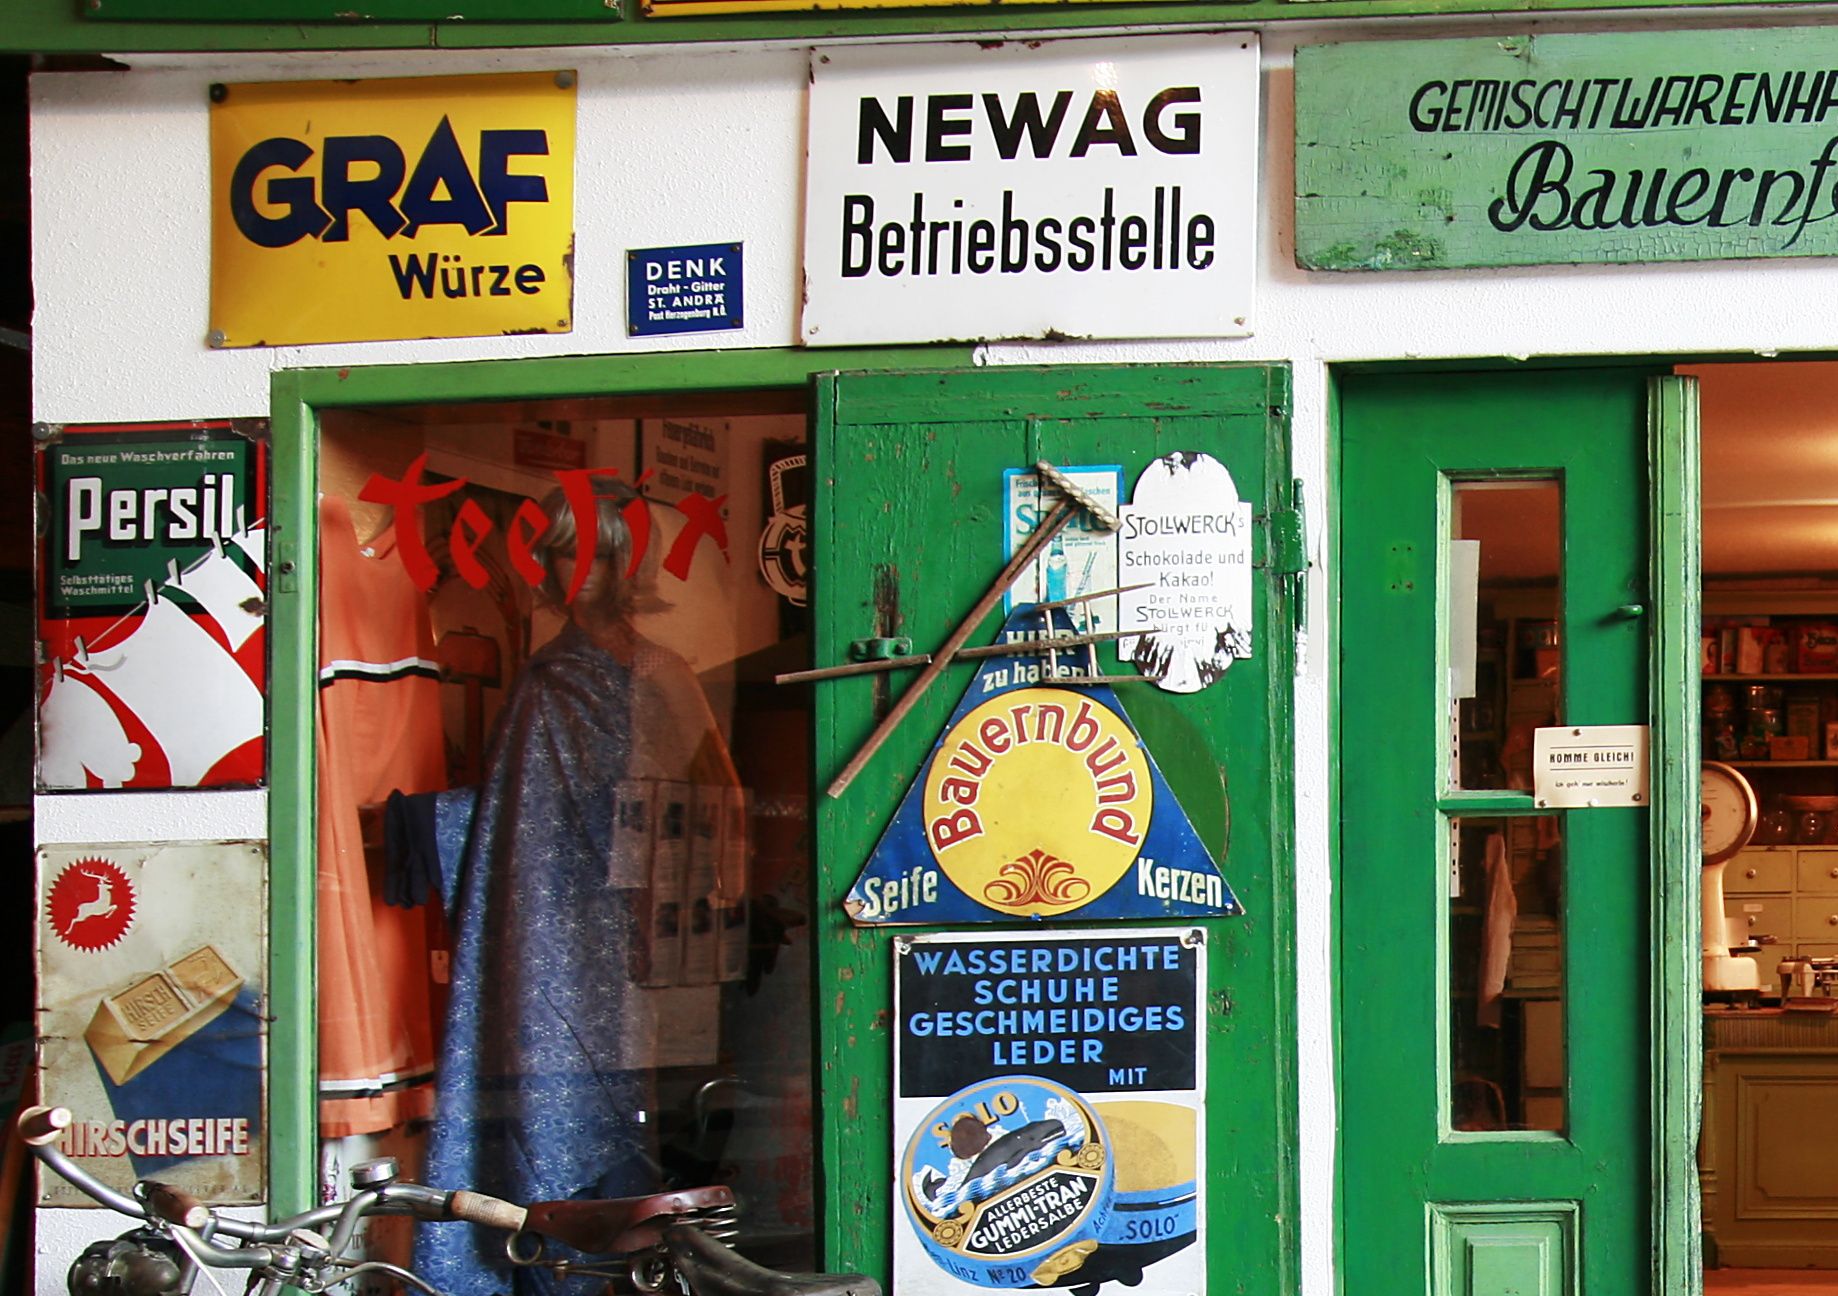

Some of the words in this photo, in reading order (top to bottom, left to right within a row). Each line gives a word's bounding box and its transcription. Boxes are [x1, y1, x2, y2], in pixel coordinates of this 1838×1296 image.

[857, 86, 1202, 165] NEWAG
[231, 114, 550, 248] GRAF
[841, 186, 1215, 277] Betriebsstelle
[389, 253, 545, 299] Würze
[646, 258, 727, 280] DENK
[648, 283, 680, 295] Draht
[691, 281, 725, 293] Gitter
[648, 298, 666, 308] ST.
[61, 453, 83, 465] Das
[87, 454, 117, 464] neue
[120, 449, 235, 463] Waschverfahren
[68, 474, 234, 561] Persil
[1126, 551, 1212, 567] Schokolade
[1218, 551, 1244, 564] und
[60, 584, 134, 596] Waschmittel
[1160, 572, 1214, 587] Kakao!
[1150, 594, 1171, 604] Der
[983, 669, 1008, 693] zu
[1550, 753, 1588, 763] KOMME
[1594, 751, 1634, 762] GLEICH!
[931, 701, 1143, 852] Bauernbund
[864, 866, 938, 918] Seife
[1138, 857, 1223, 908] Kerzen
[913, 945, 1180, 975] WASSERDICHTE
[974, 976, 1119, 1005] SCHUHE
[909, 1006, 1185, 1036] GESCHMEIDIGES
[993, 1039, 1105, 1066] LEDER
[1109, 1067, 1148, 1086] MIT
[932, 1091, 1020, 1148] SLO
[971, 1177, 1088, 1248] GUMMI-TRAN
[988, 1176, 1059, 1222] ALLERBESTE
[995, 1198, 1084, 1253] LEDERSALBE
[1010, 1266, 1026, 1282] 20
